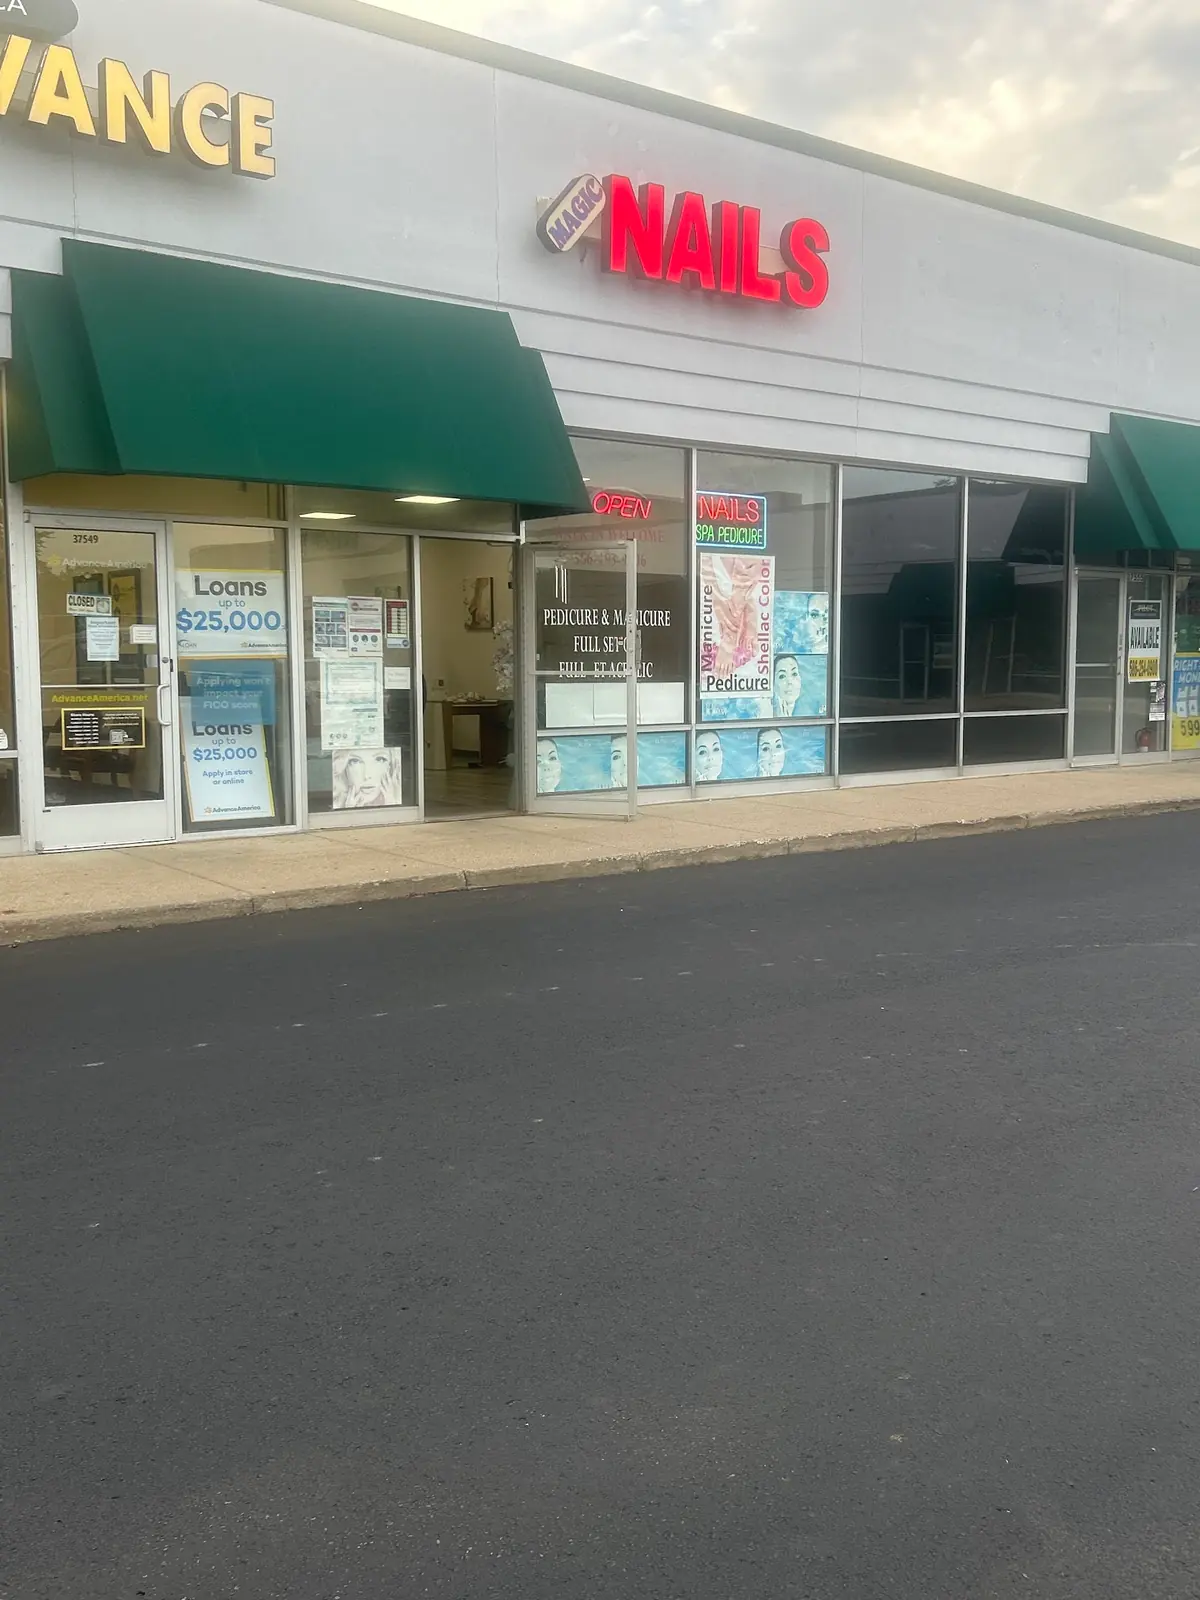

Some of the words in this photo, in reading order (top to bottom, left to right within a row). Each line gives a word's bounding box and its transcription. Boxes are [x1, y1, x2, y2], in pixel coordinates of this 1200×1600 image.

[0, 0, 28, 16] A
[548, 178, 604, 249] MAGIC
[601, 173, 830, 309] NAILS
[592, 492, 652, 519] OPEN
[699, 495, 760, 523] NAILS
[73, 534, 99, 544] 37549
[696, 524, 714, 541] SPA
[718, 526, 763, 545] PEDICURE
[194, 574, 268, 597] Loans
[759, 559, 770, 607] Color
[68, 595, 95, 607] CLOSED
[218, 599, 232, 609] up
[234, 598, 246, 608] to
[176, 607, 281, 634] $25,000
[543, 608, 599, 626] PEDICURE
[601, 609, 610, 626] &
[613, 609, 671, 627] MICURE
[701, 584, 713, 672] Manicure
[574, 635, 601, 652] FULL
[758, 612, 770, 675] Shellac
[1131, 626, 1159, 649] AVAILABLE
[559, 661, 586, 678] FULL
[610, 661, 654, 678] ACLIC
[1174, 660, 1199, 671] RIGHT
[196, 676, 241, 687] Applying
[706, 674, 769, 691] Pedicure
[52, 694, 148, 703] AdvanceAmerica.net
[204, 690, 238, 701] impact
[203, 701, 229, 709] FICO
[231, 701, 259, 709] score
[192, 720, 253, 736] Loans
[212, 739, 223, 748] up
[193, 747, 257, 762] $25,000
[202, 770, 224, 778] Apply
